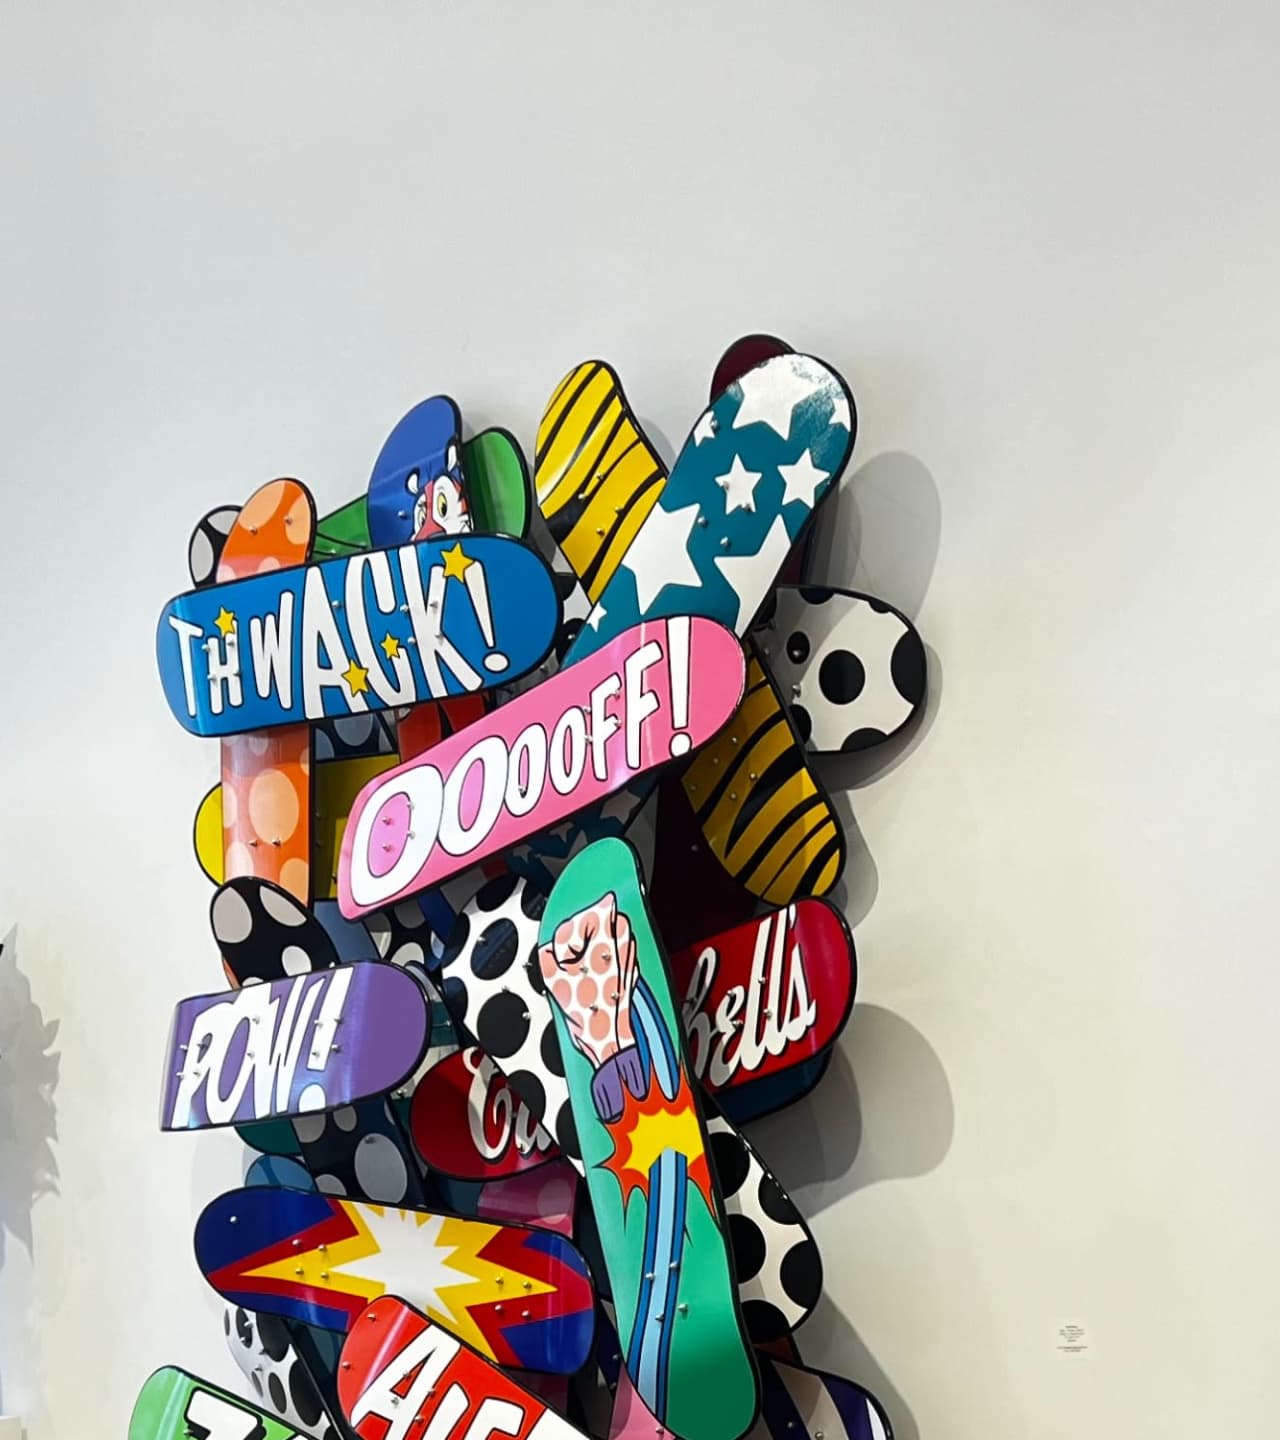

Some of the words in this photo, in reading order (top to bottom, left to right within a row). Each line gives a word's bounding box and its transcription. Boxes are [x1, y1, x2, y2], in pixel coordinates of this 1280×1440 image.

[169, 546, 510, 720] THWACK!
[350, 615, 693, 906] OOOOFF!
[171, 966, 354, 1128] POW!
